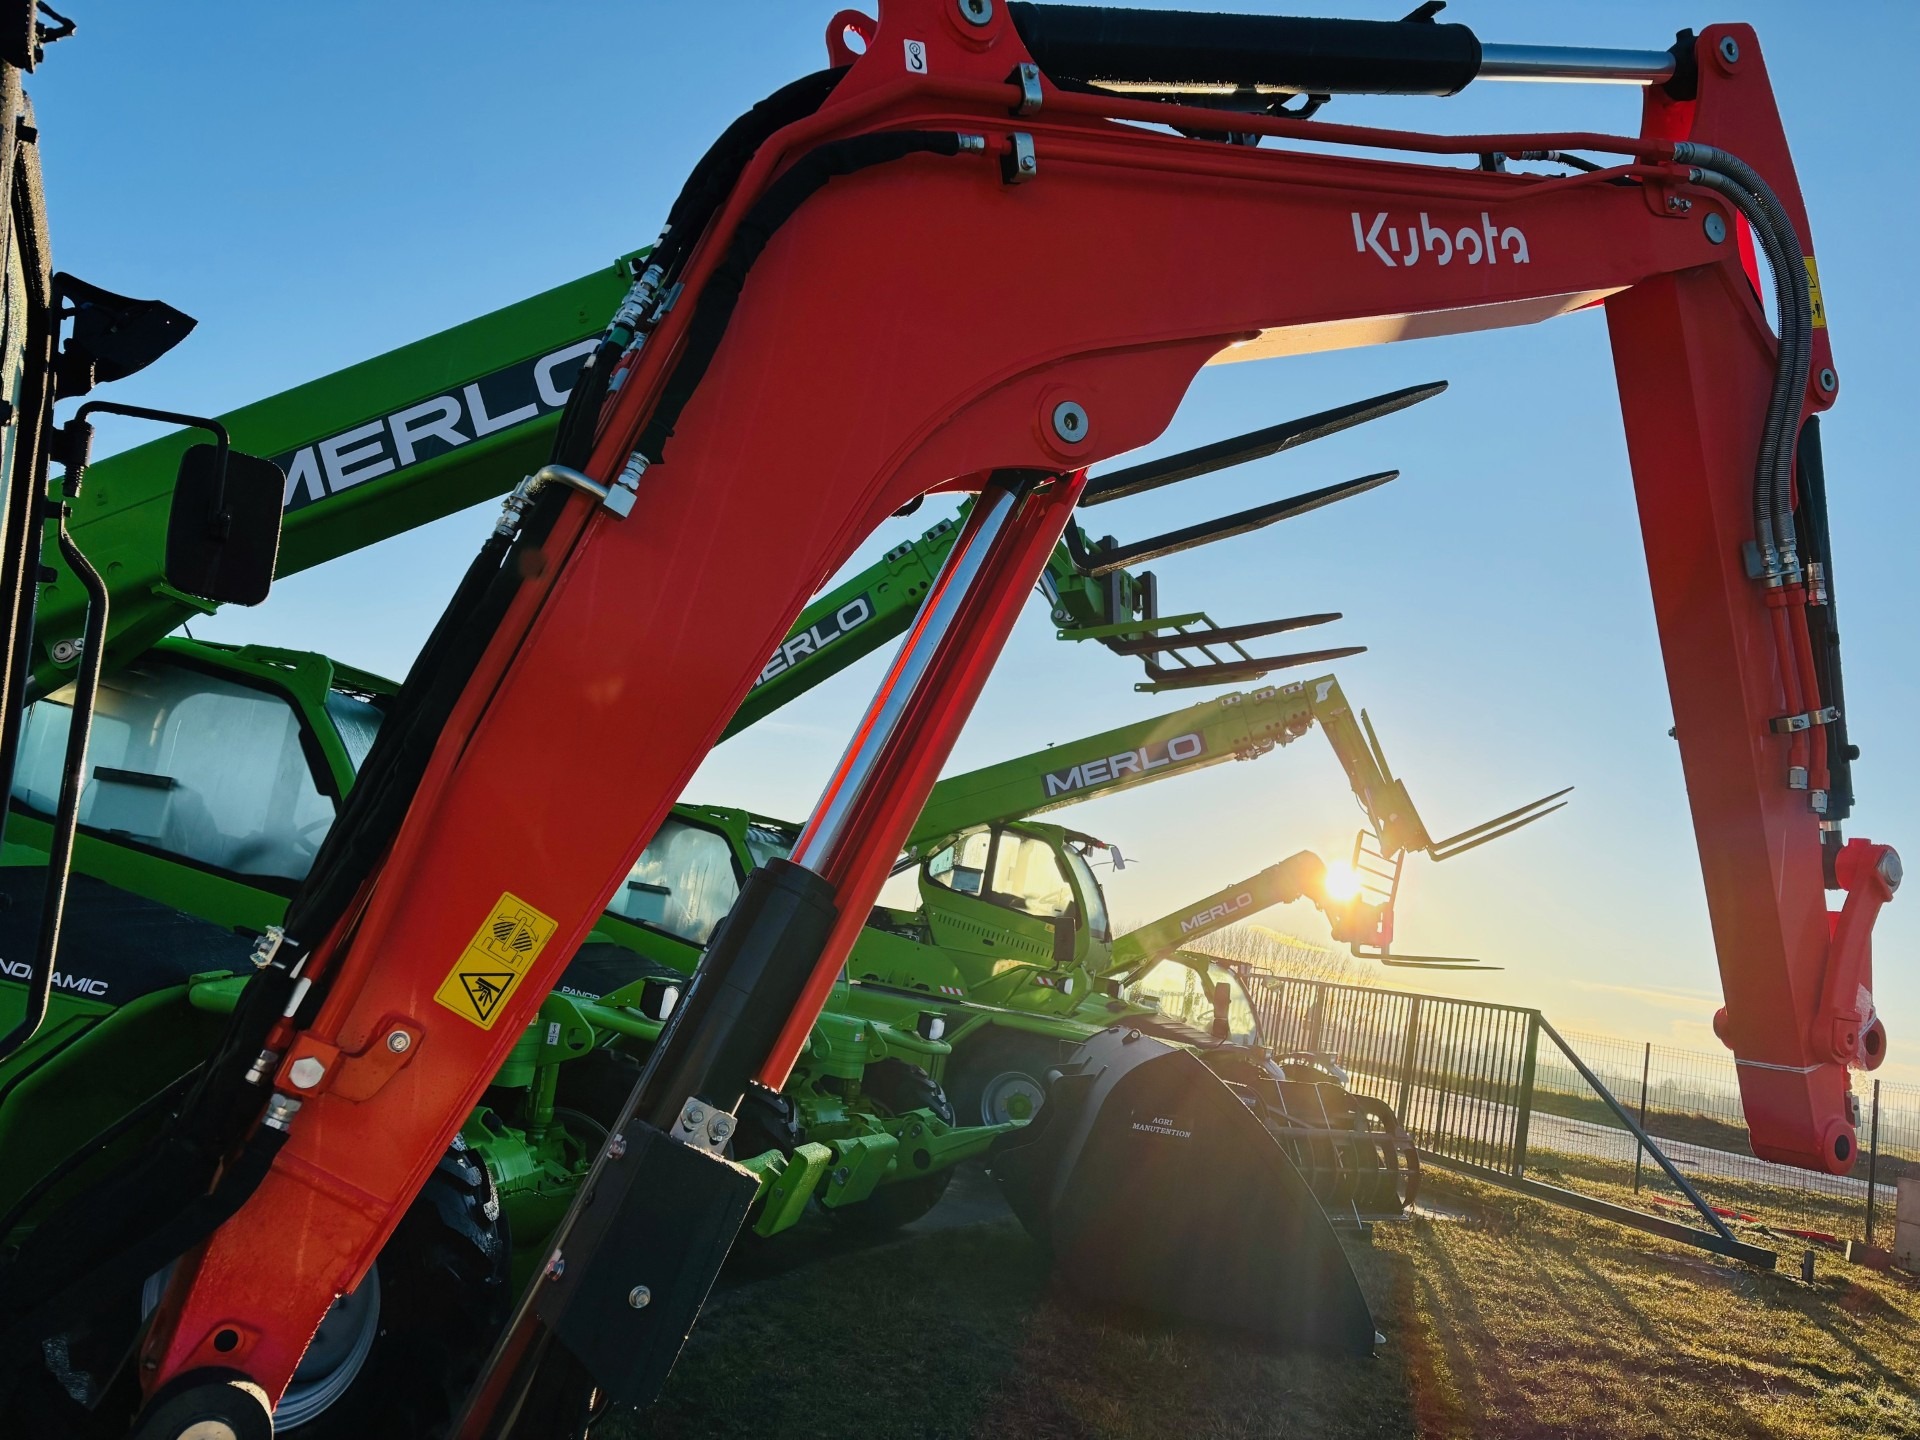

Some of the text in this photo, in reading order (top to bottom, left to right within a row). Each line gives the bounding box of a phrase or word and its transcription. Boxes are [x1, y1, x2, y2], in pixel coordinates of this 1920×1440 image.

[1351, 212, 1530, 267] Kubota
[755, 598, 869, 687] ERLO
[1045, 733, 1202, 796] MERLO
[1180, 892, 1252, 933] MERLO
[0, 958, 109, 996] NOAMIC
[1132, 1122, 1191, 1138] MANUTENTION
[1152, 1117, 1173, 1126] AGRI
